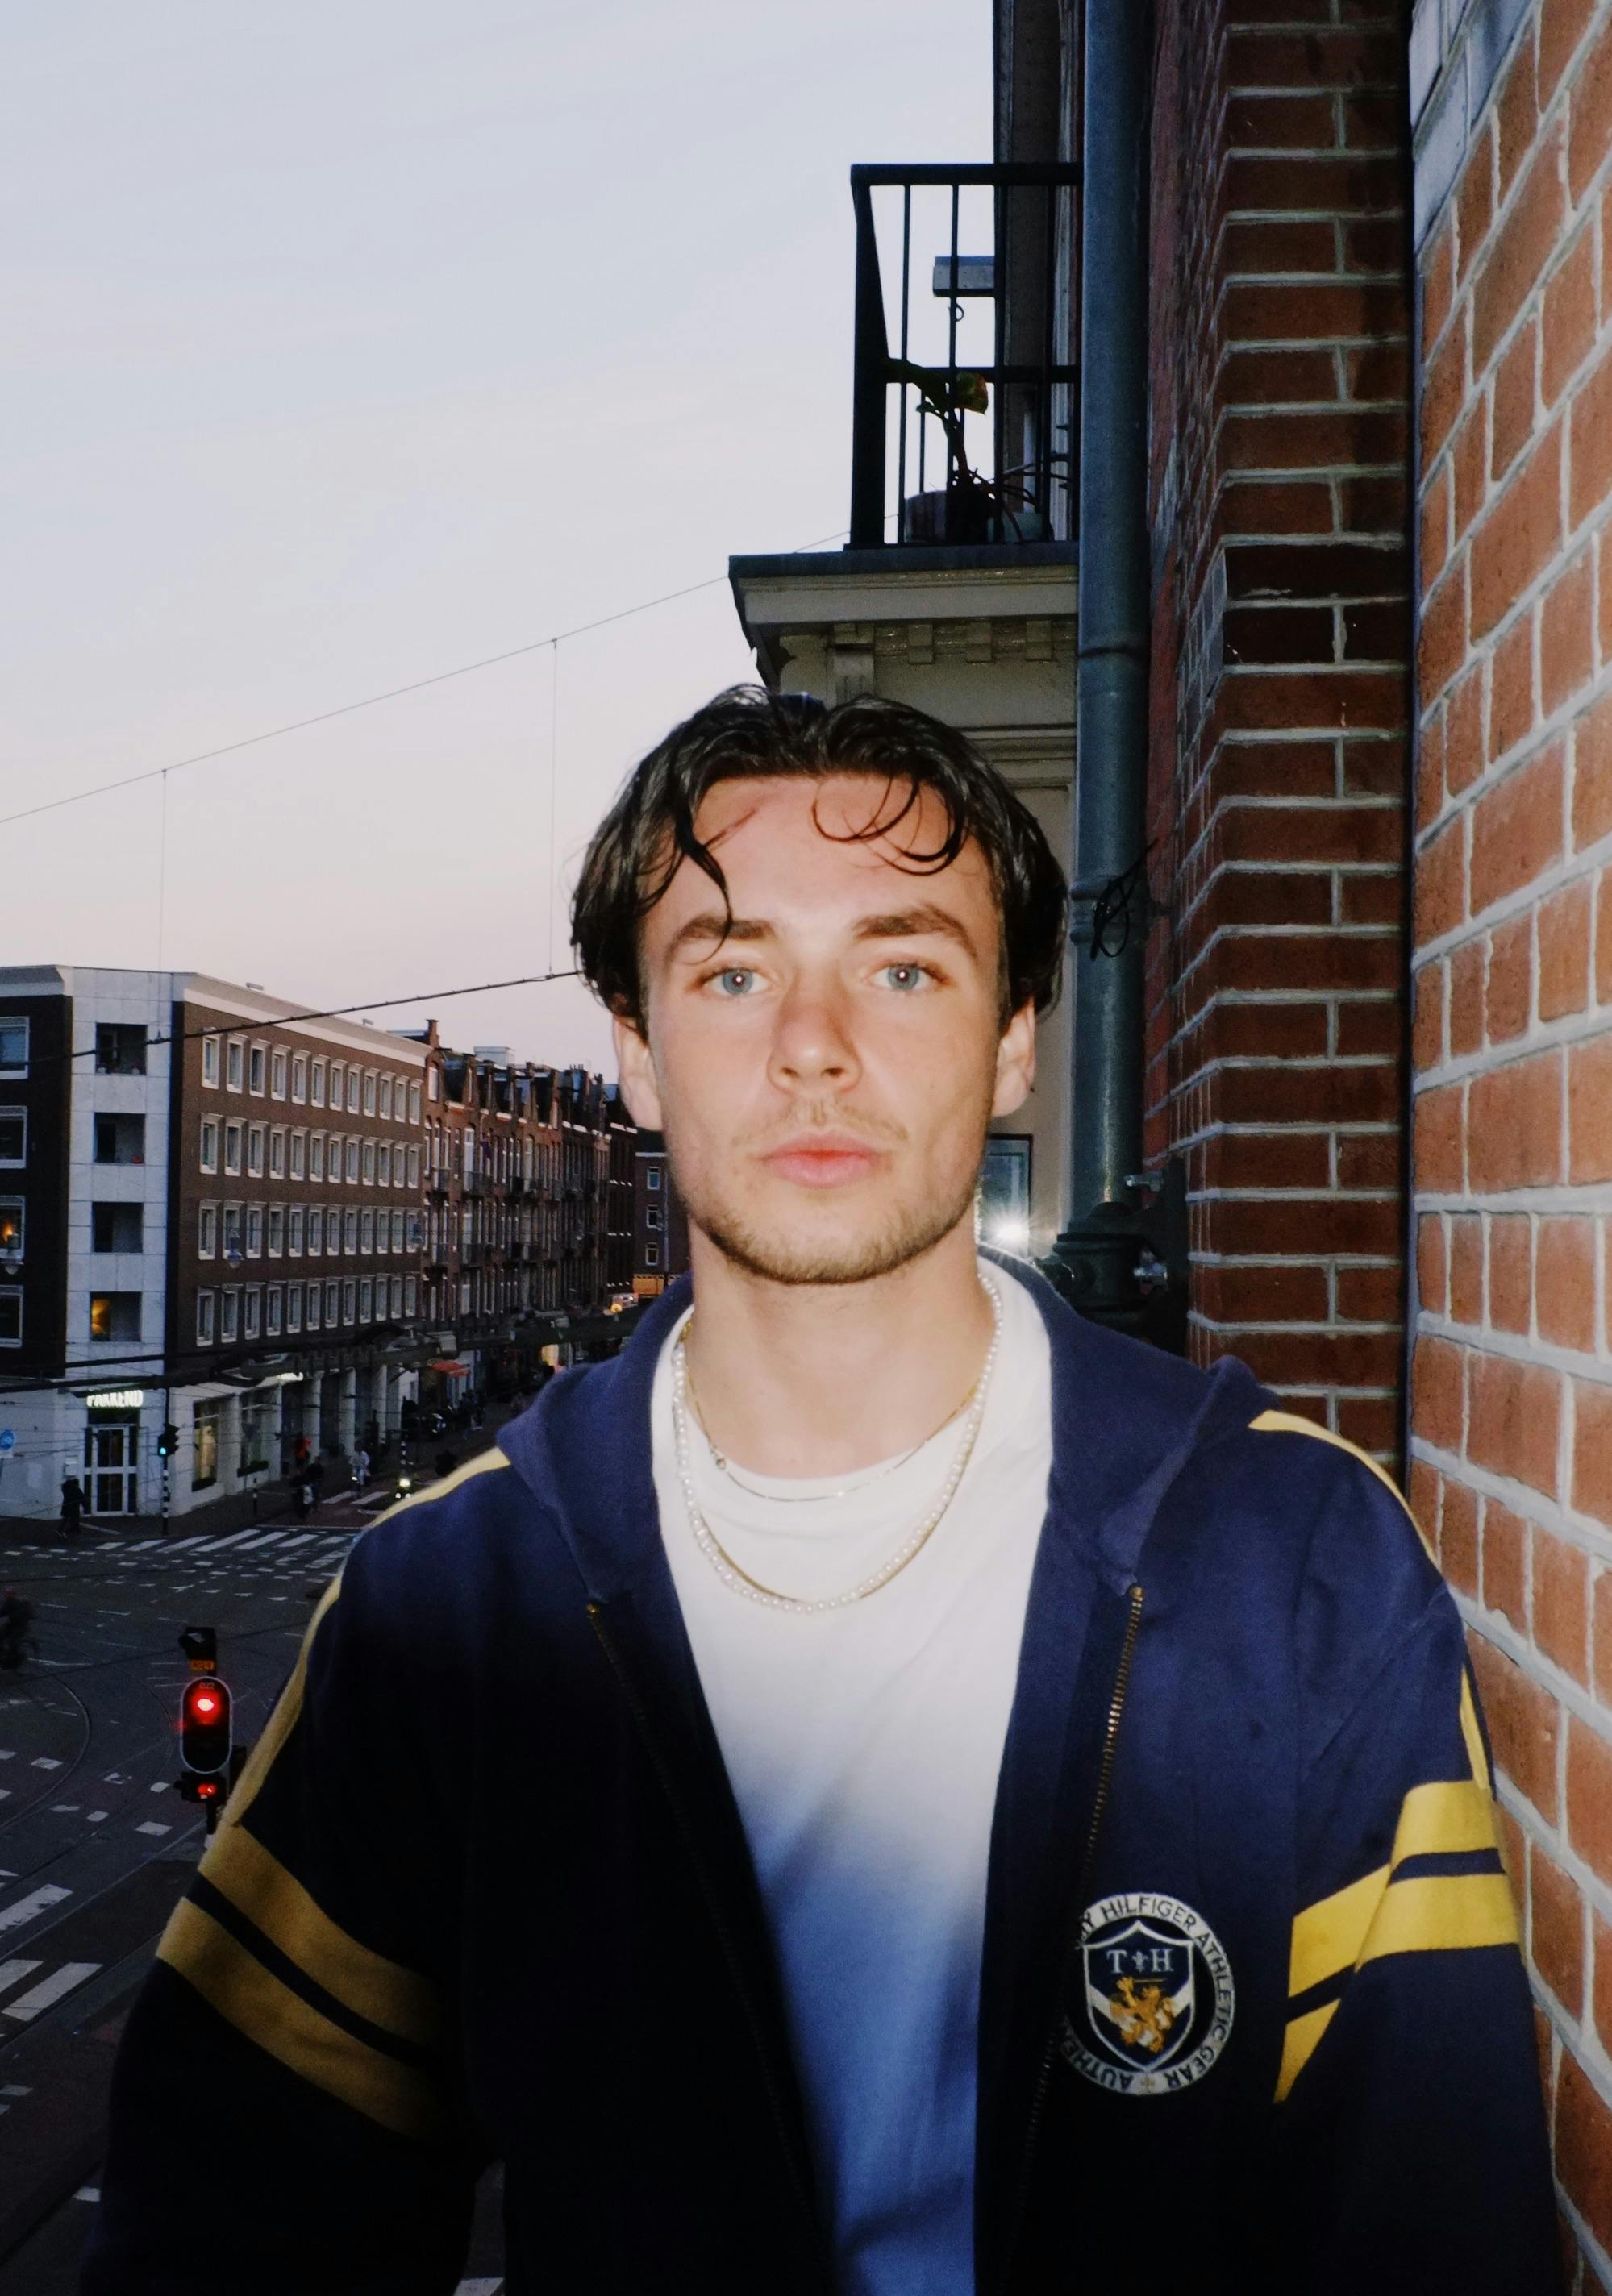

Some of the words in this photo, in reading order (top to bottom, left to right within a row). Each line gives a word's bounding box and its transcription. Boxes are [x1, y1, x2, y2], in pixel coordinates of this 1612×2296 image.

[1102, 1895, 1197, 1932] HILFIGER
[1106, 1949, 1127, 1974] T
[1151, 1948, 1174, 1973] H
[1193, 1932, 1231, 2042] ATHLETIC
[1164, 2045, 1215, 2089] GEAR
